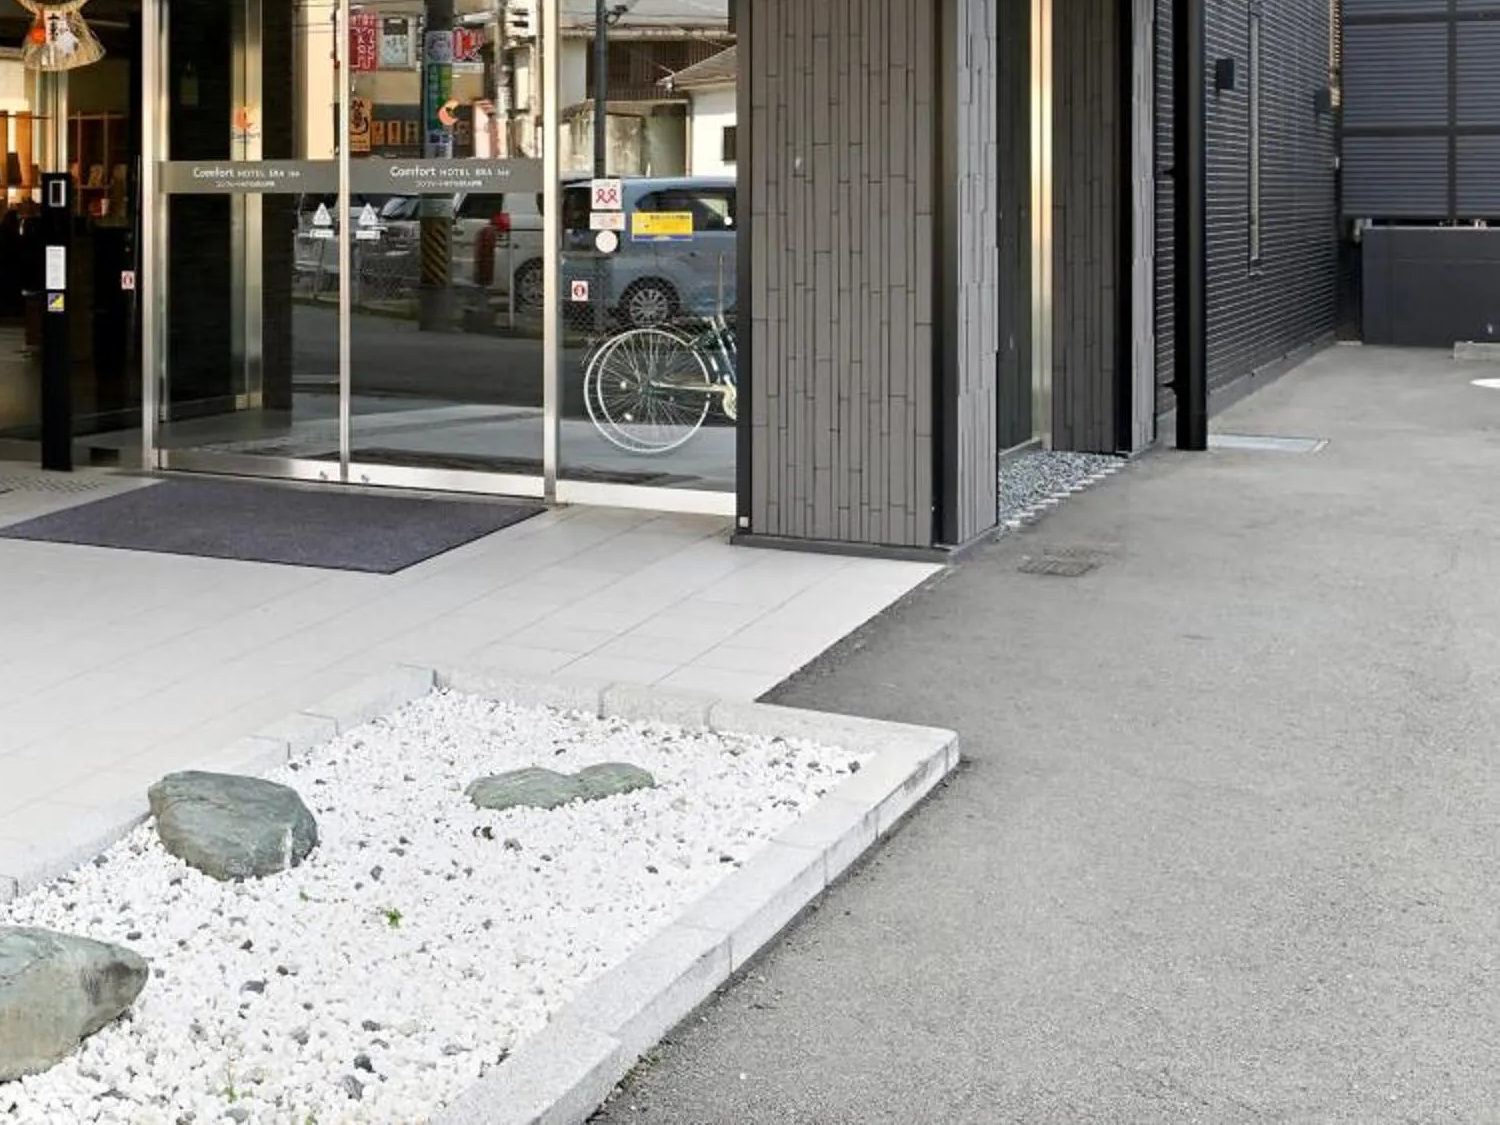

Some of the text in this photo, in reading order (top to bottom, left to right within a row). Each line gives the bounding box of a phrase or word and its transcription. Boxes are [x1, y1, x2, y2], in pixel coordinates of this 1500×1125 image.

[193, 166, 235, 178] Comfort
[237, 169, 266, 178] HOTEL
[389, 165, 436, 178] Comfort
[439, 168, 471, 177] HOTEL
